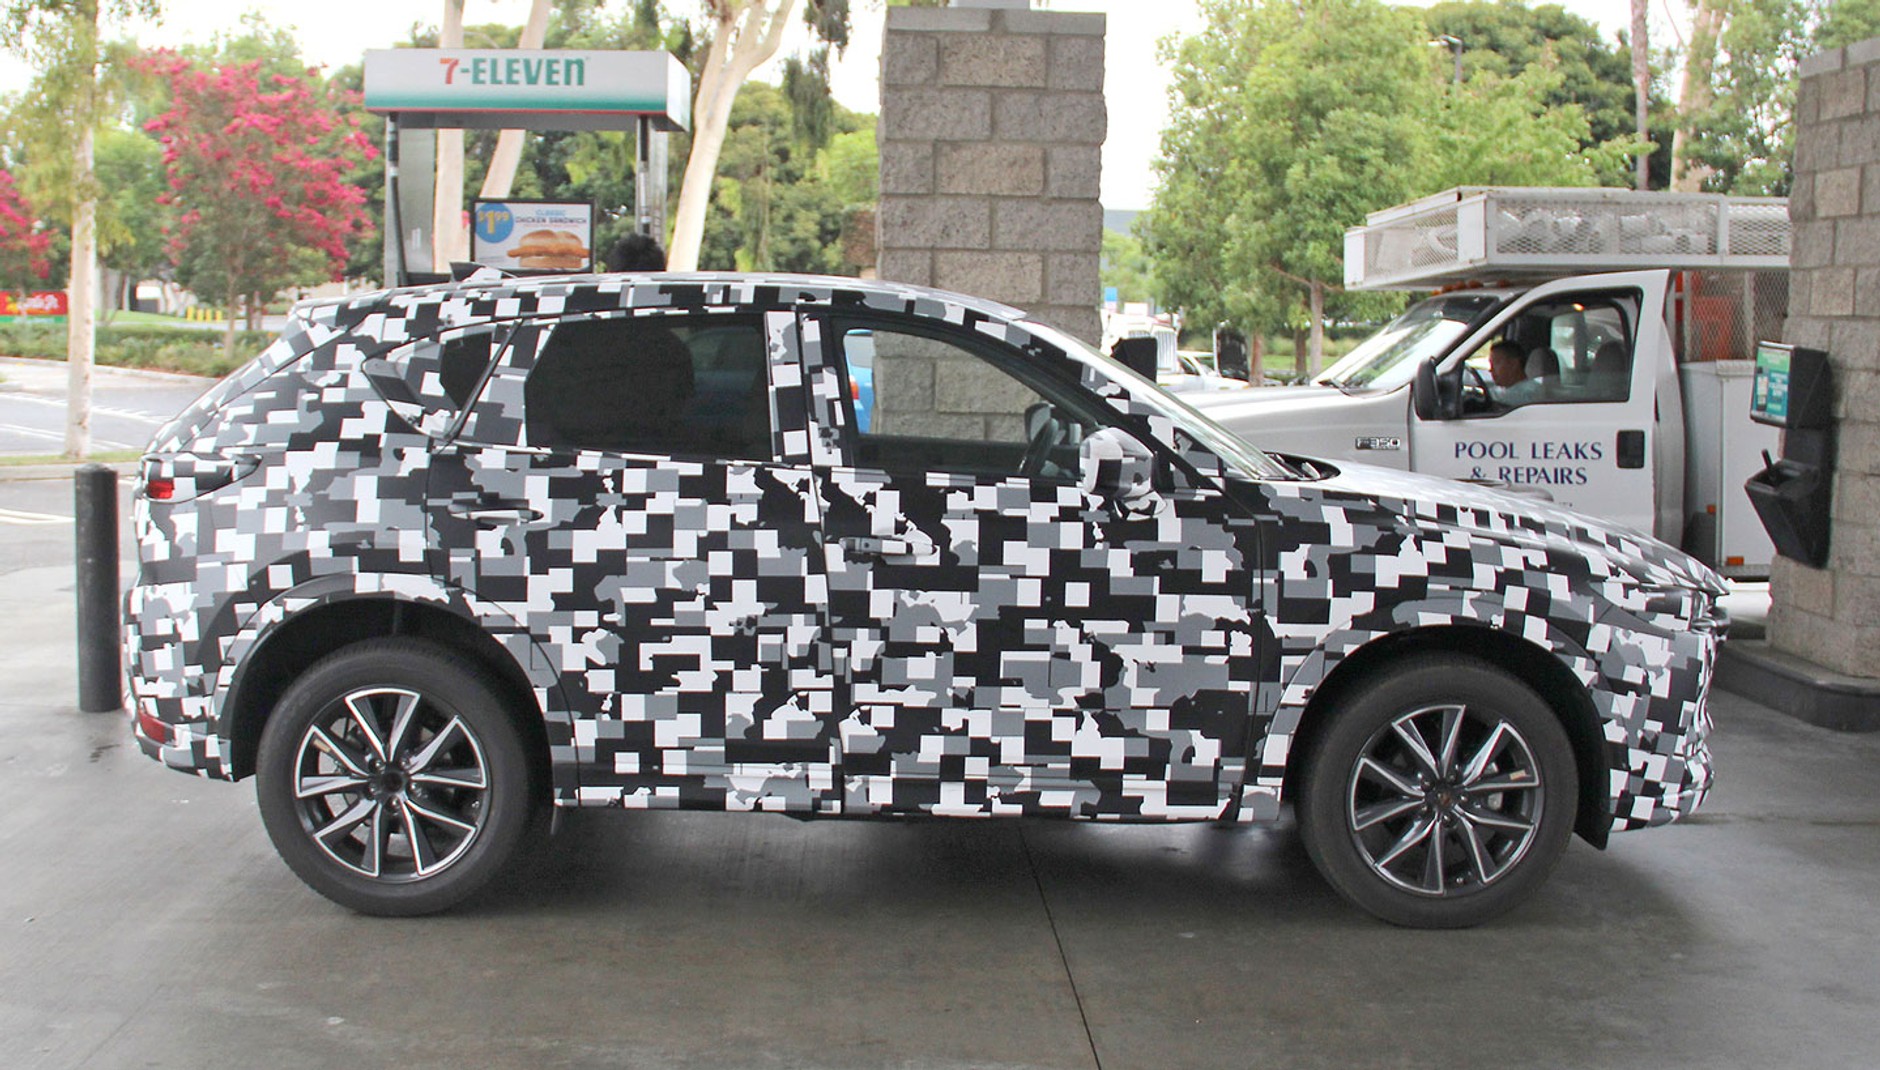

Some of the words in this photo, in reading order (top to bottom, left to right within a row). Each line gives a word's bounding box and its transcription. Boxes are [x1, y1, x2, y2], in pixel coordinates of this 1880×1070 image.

[515, 216, 546, 224] CHICKEN
[548, 216, 587, 225] SANDWICH
[1455, 441, 1519, 460] POOL
[1531, 441, 1603, 461] LEAKS
[1470, 466, 1487, 480] &
[1499, 466, 1588, 485] REPAIRS
